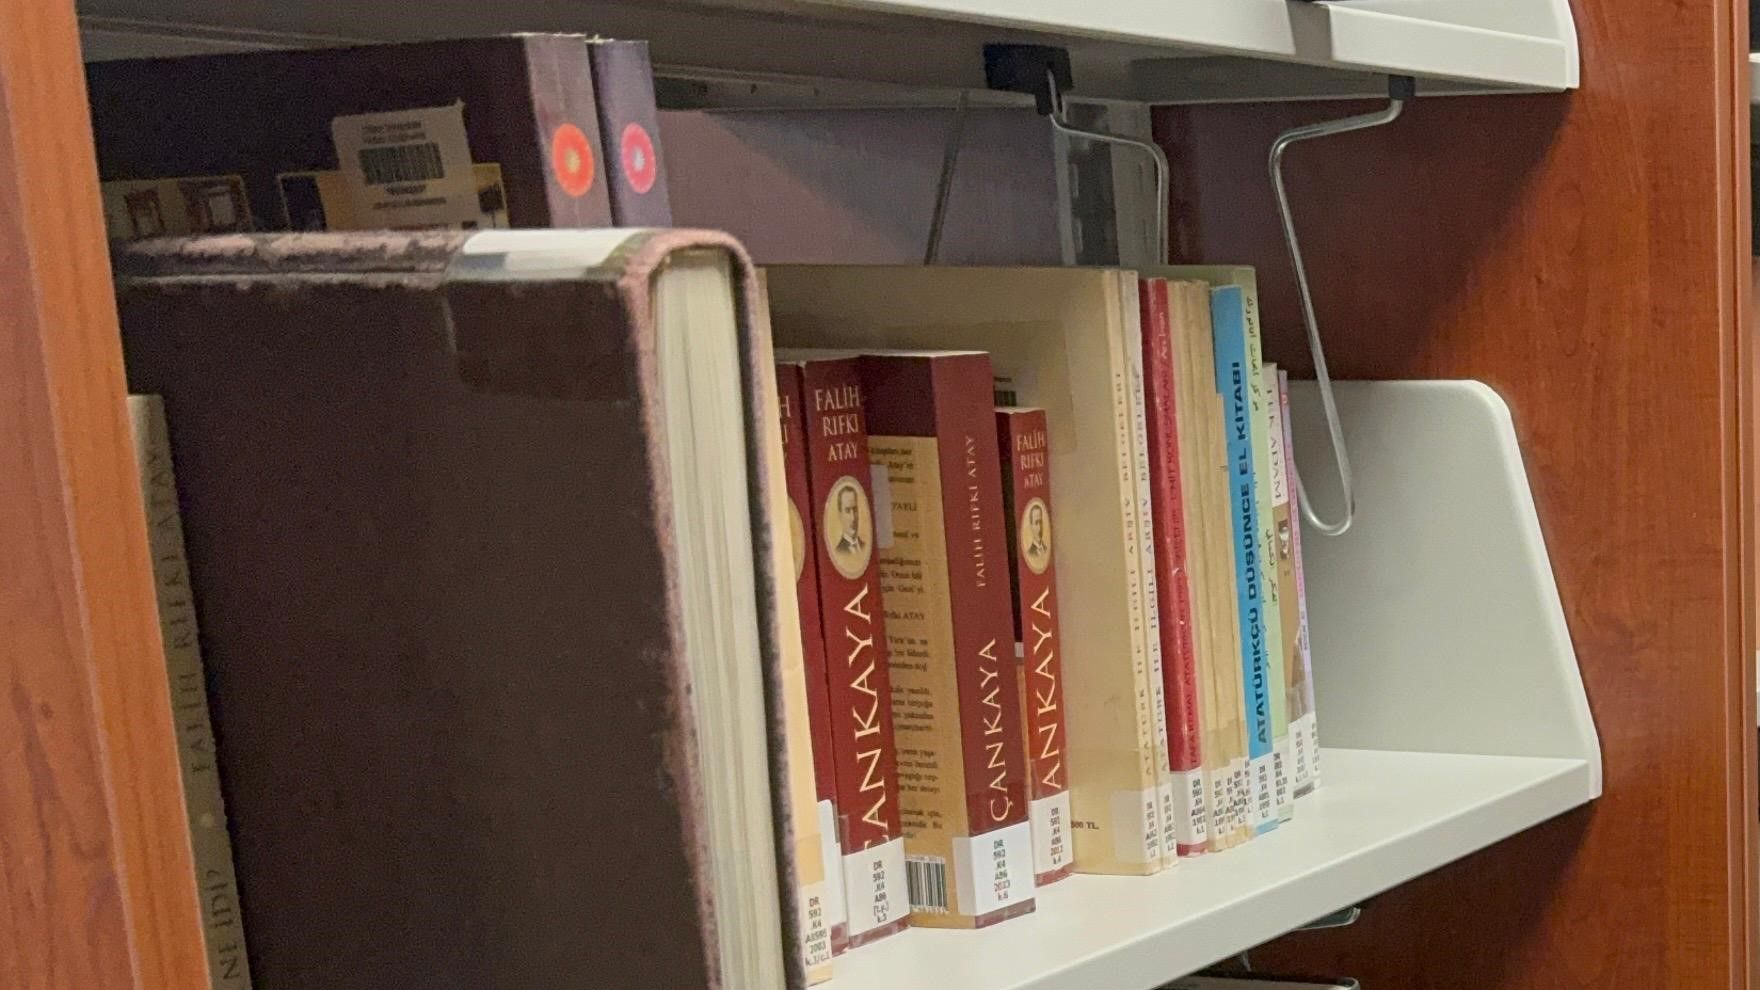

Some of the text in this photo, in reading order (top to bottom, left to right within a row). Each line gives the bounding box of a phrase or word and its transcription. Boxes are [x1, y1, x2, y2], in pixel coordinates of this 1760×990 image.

[814, 384, 862, 412] FALİH
[822, 412, 860, 437] RIFKI
[827, 442, 859, 463] ATAY
[1023, 471, 1044, 489] ATAY
[1271, 436, 1282, 500] ADAM
[1231, 361, 1267, 744] ATATÜRKÇÜ DÜŞÜNCE EL KİTABI
[978, 637, 1014, 822] ÇANKAYA
[872, 870, 885, 883] 592
[873, 859, 883, 871] DR
